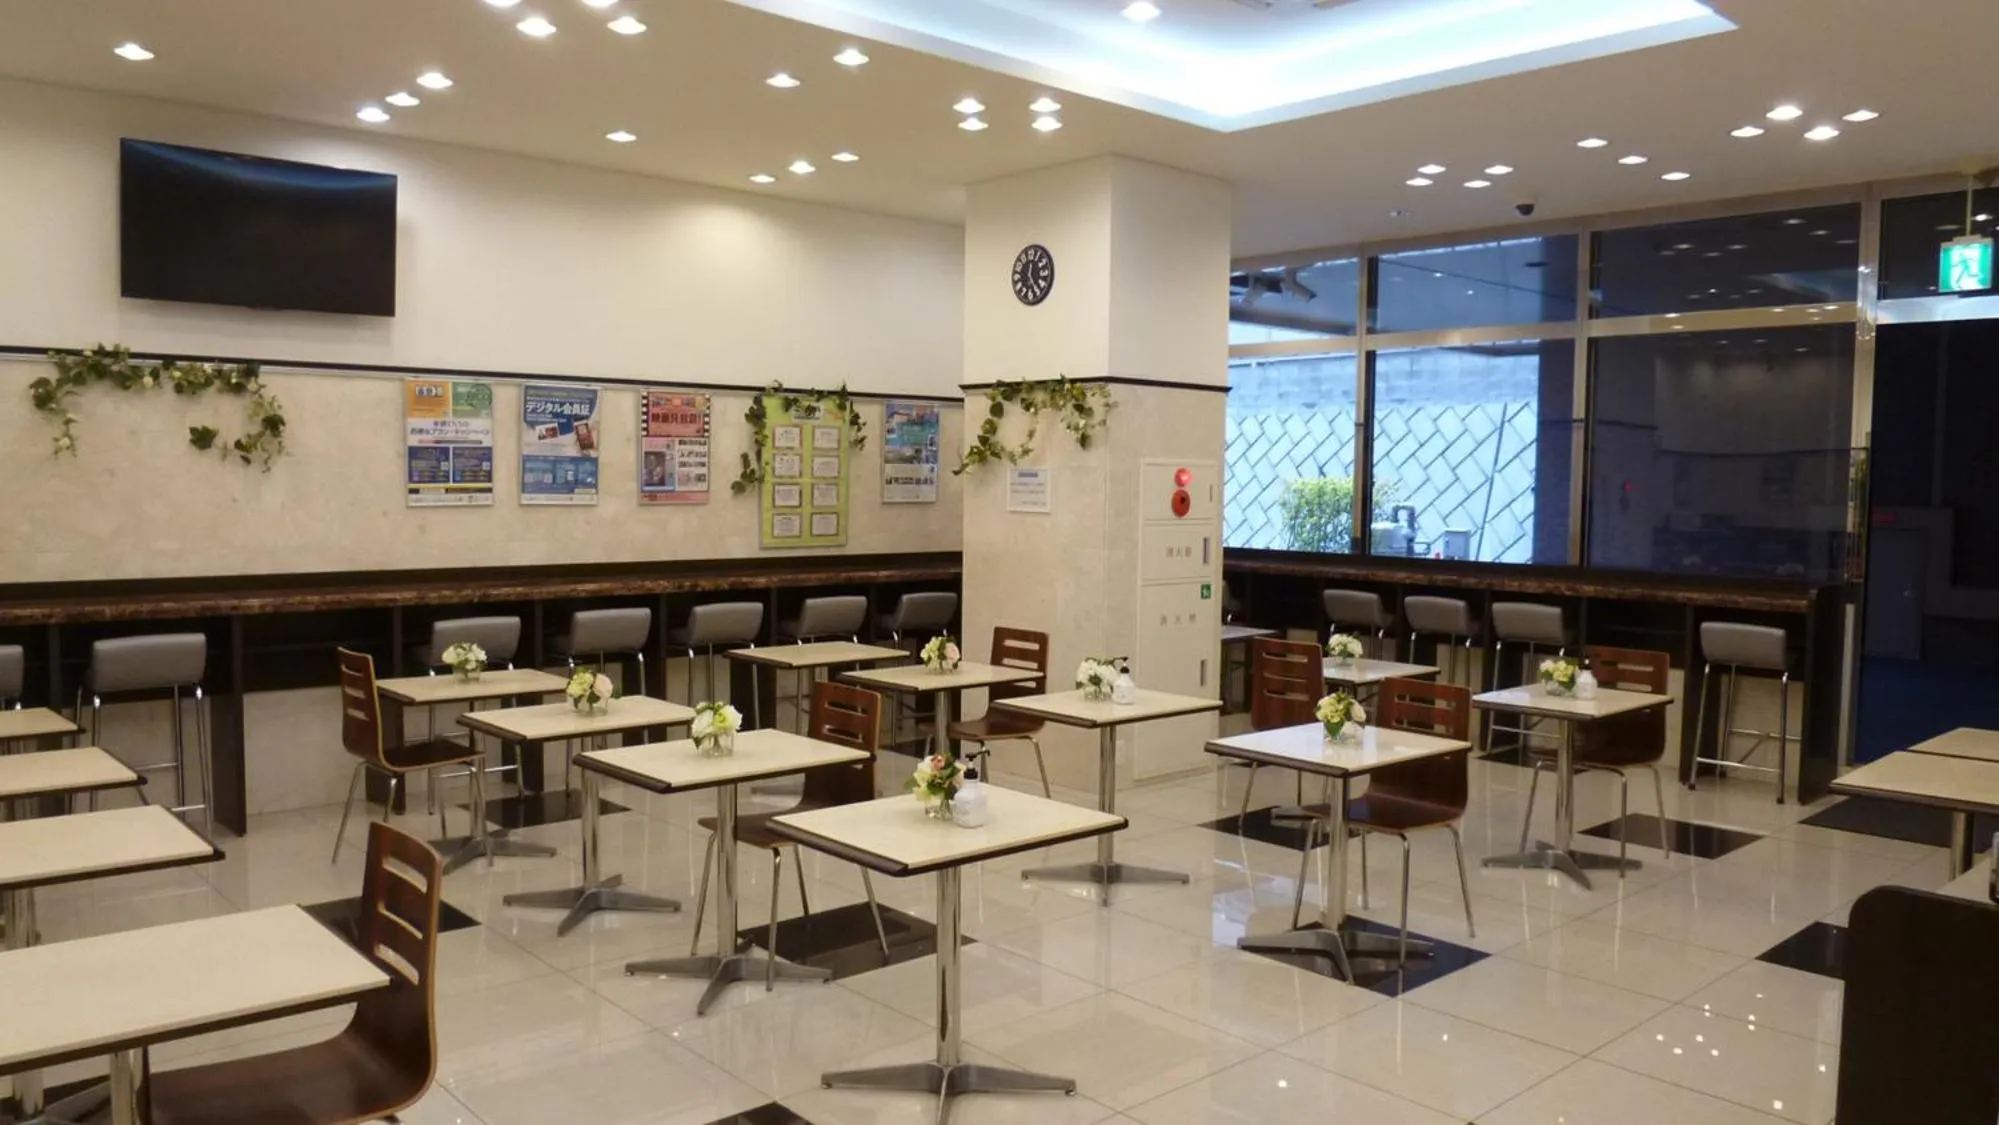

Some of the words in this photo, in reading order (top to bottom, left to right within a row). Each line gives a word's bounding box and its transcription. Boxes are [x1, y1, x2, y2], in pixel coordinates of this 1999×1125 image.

[526, 401, 591, 416] デジタル会員証
